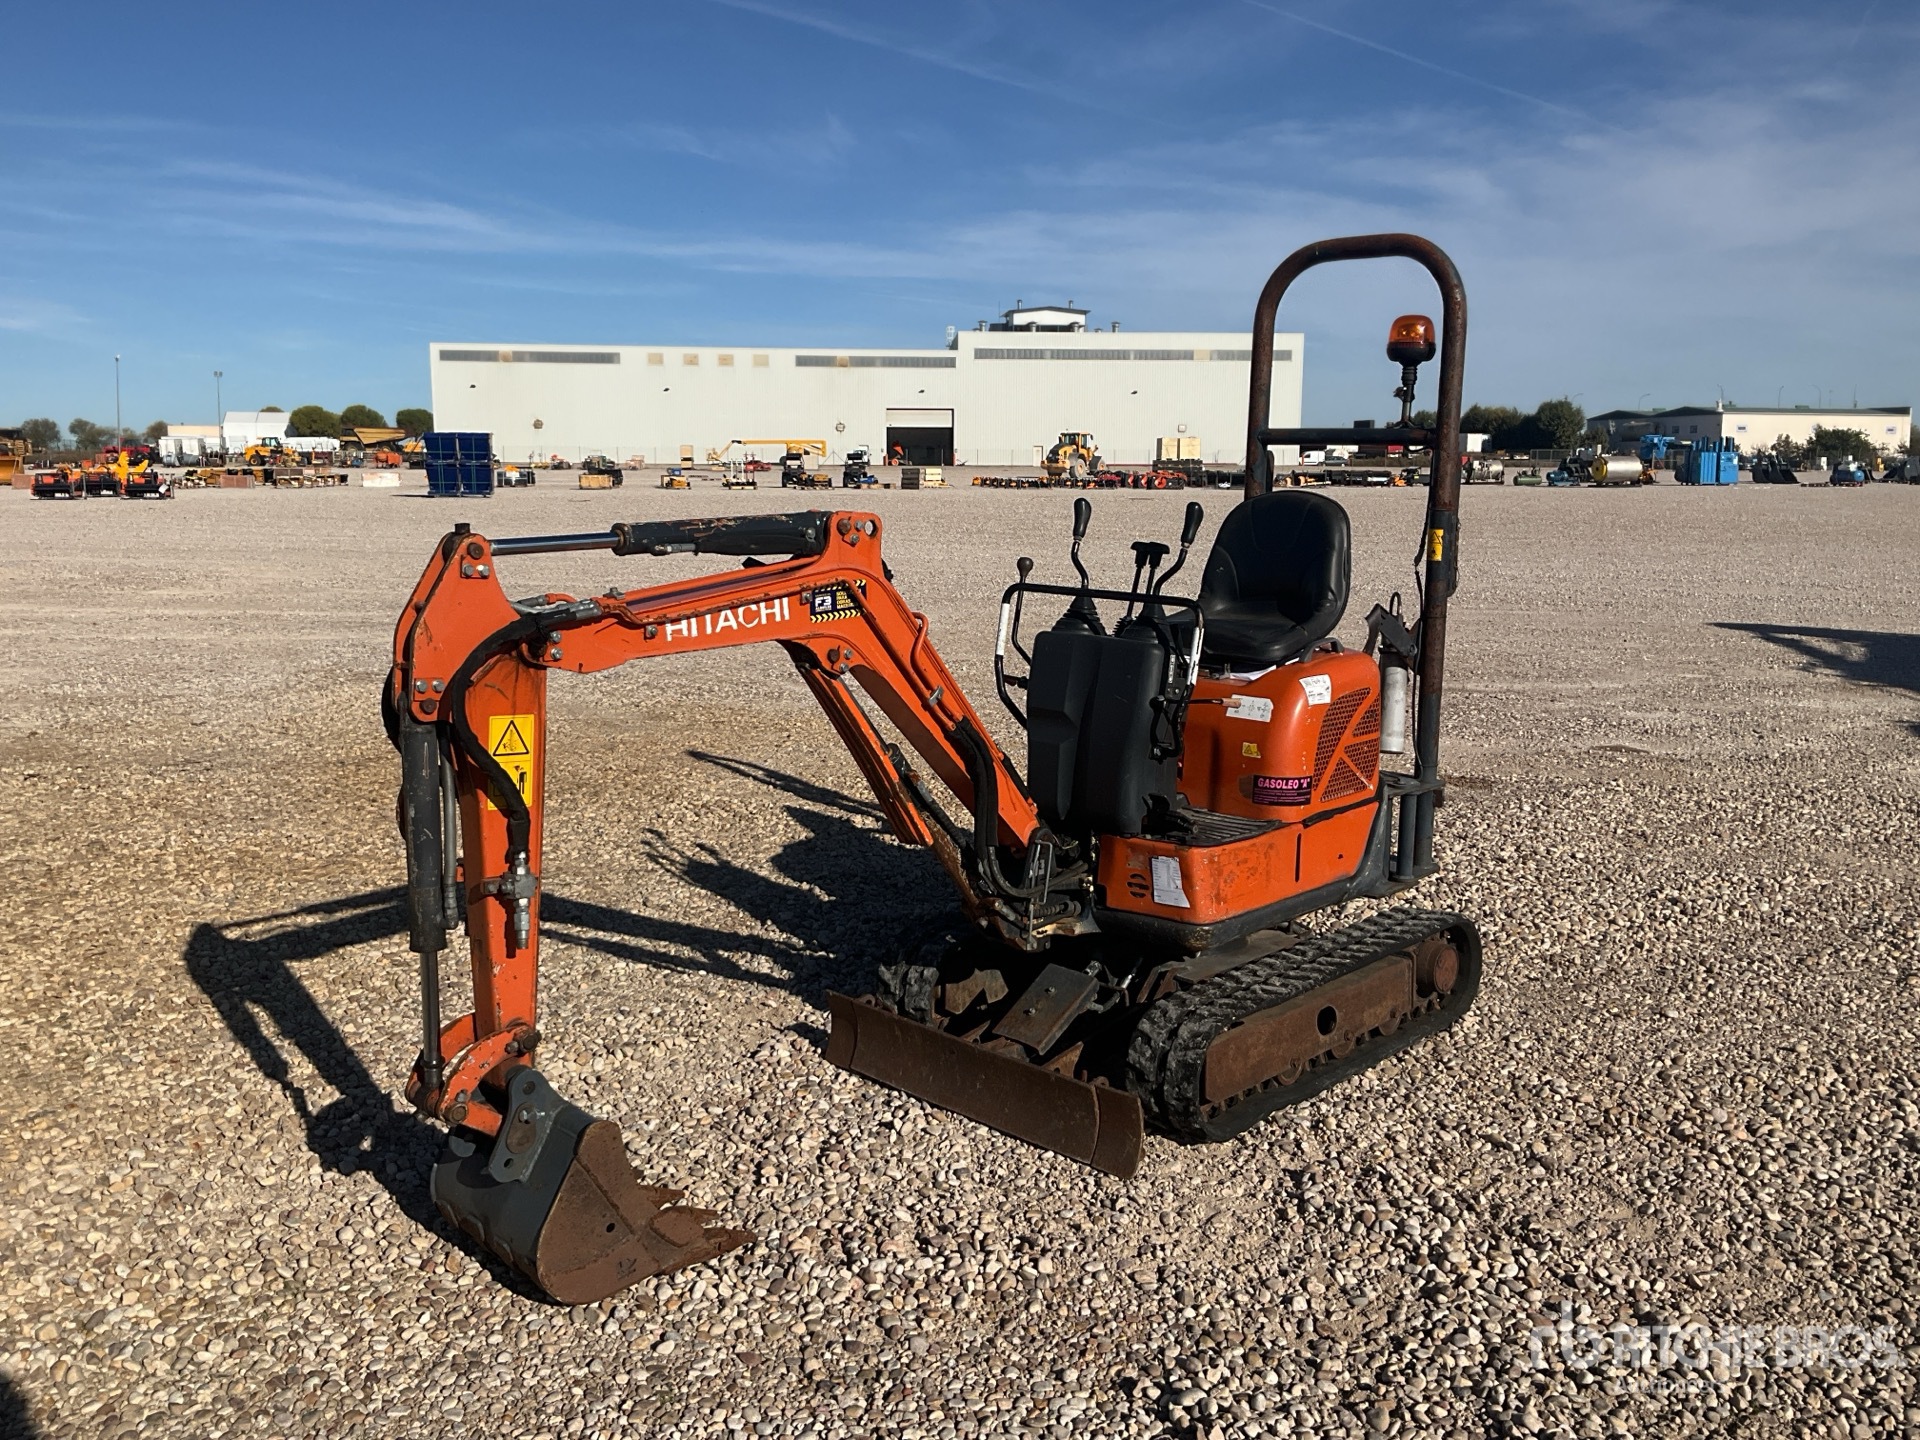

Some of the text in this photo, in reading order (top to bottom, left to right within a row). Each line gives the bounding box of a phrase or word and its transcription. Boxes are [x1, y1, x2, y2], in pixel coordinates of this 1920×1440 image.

[815, 596, 831, 607] F3
[665, 597, 790, 641] HITACHI
[1257, 778, 1299, 789] GASOLEO
